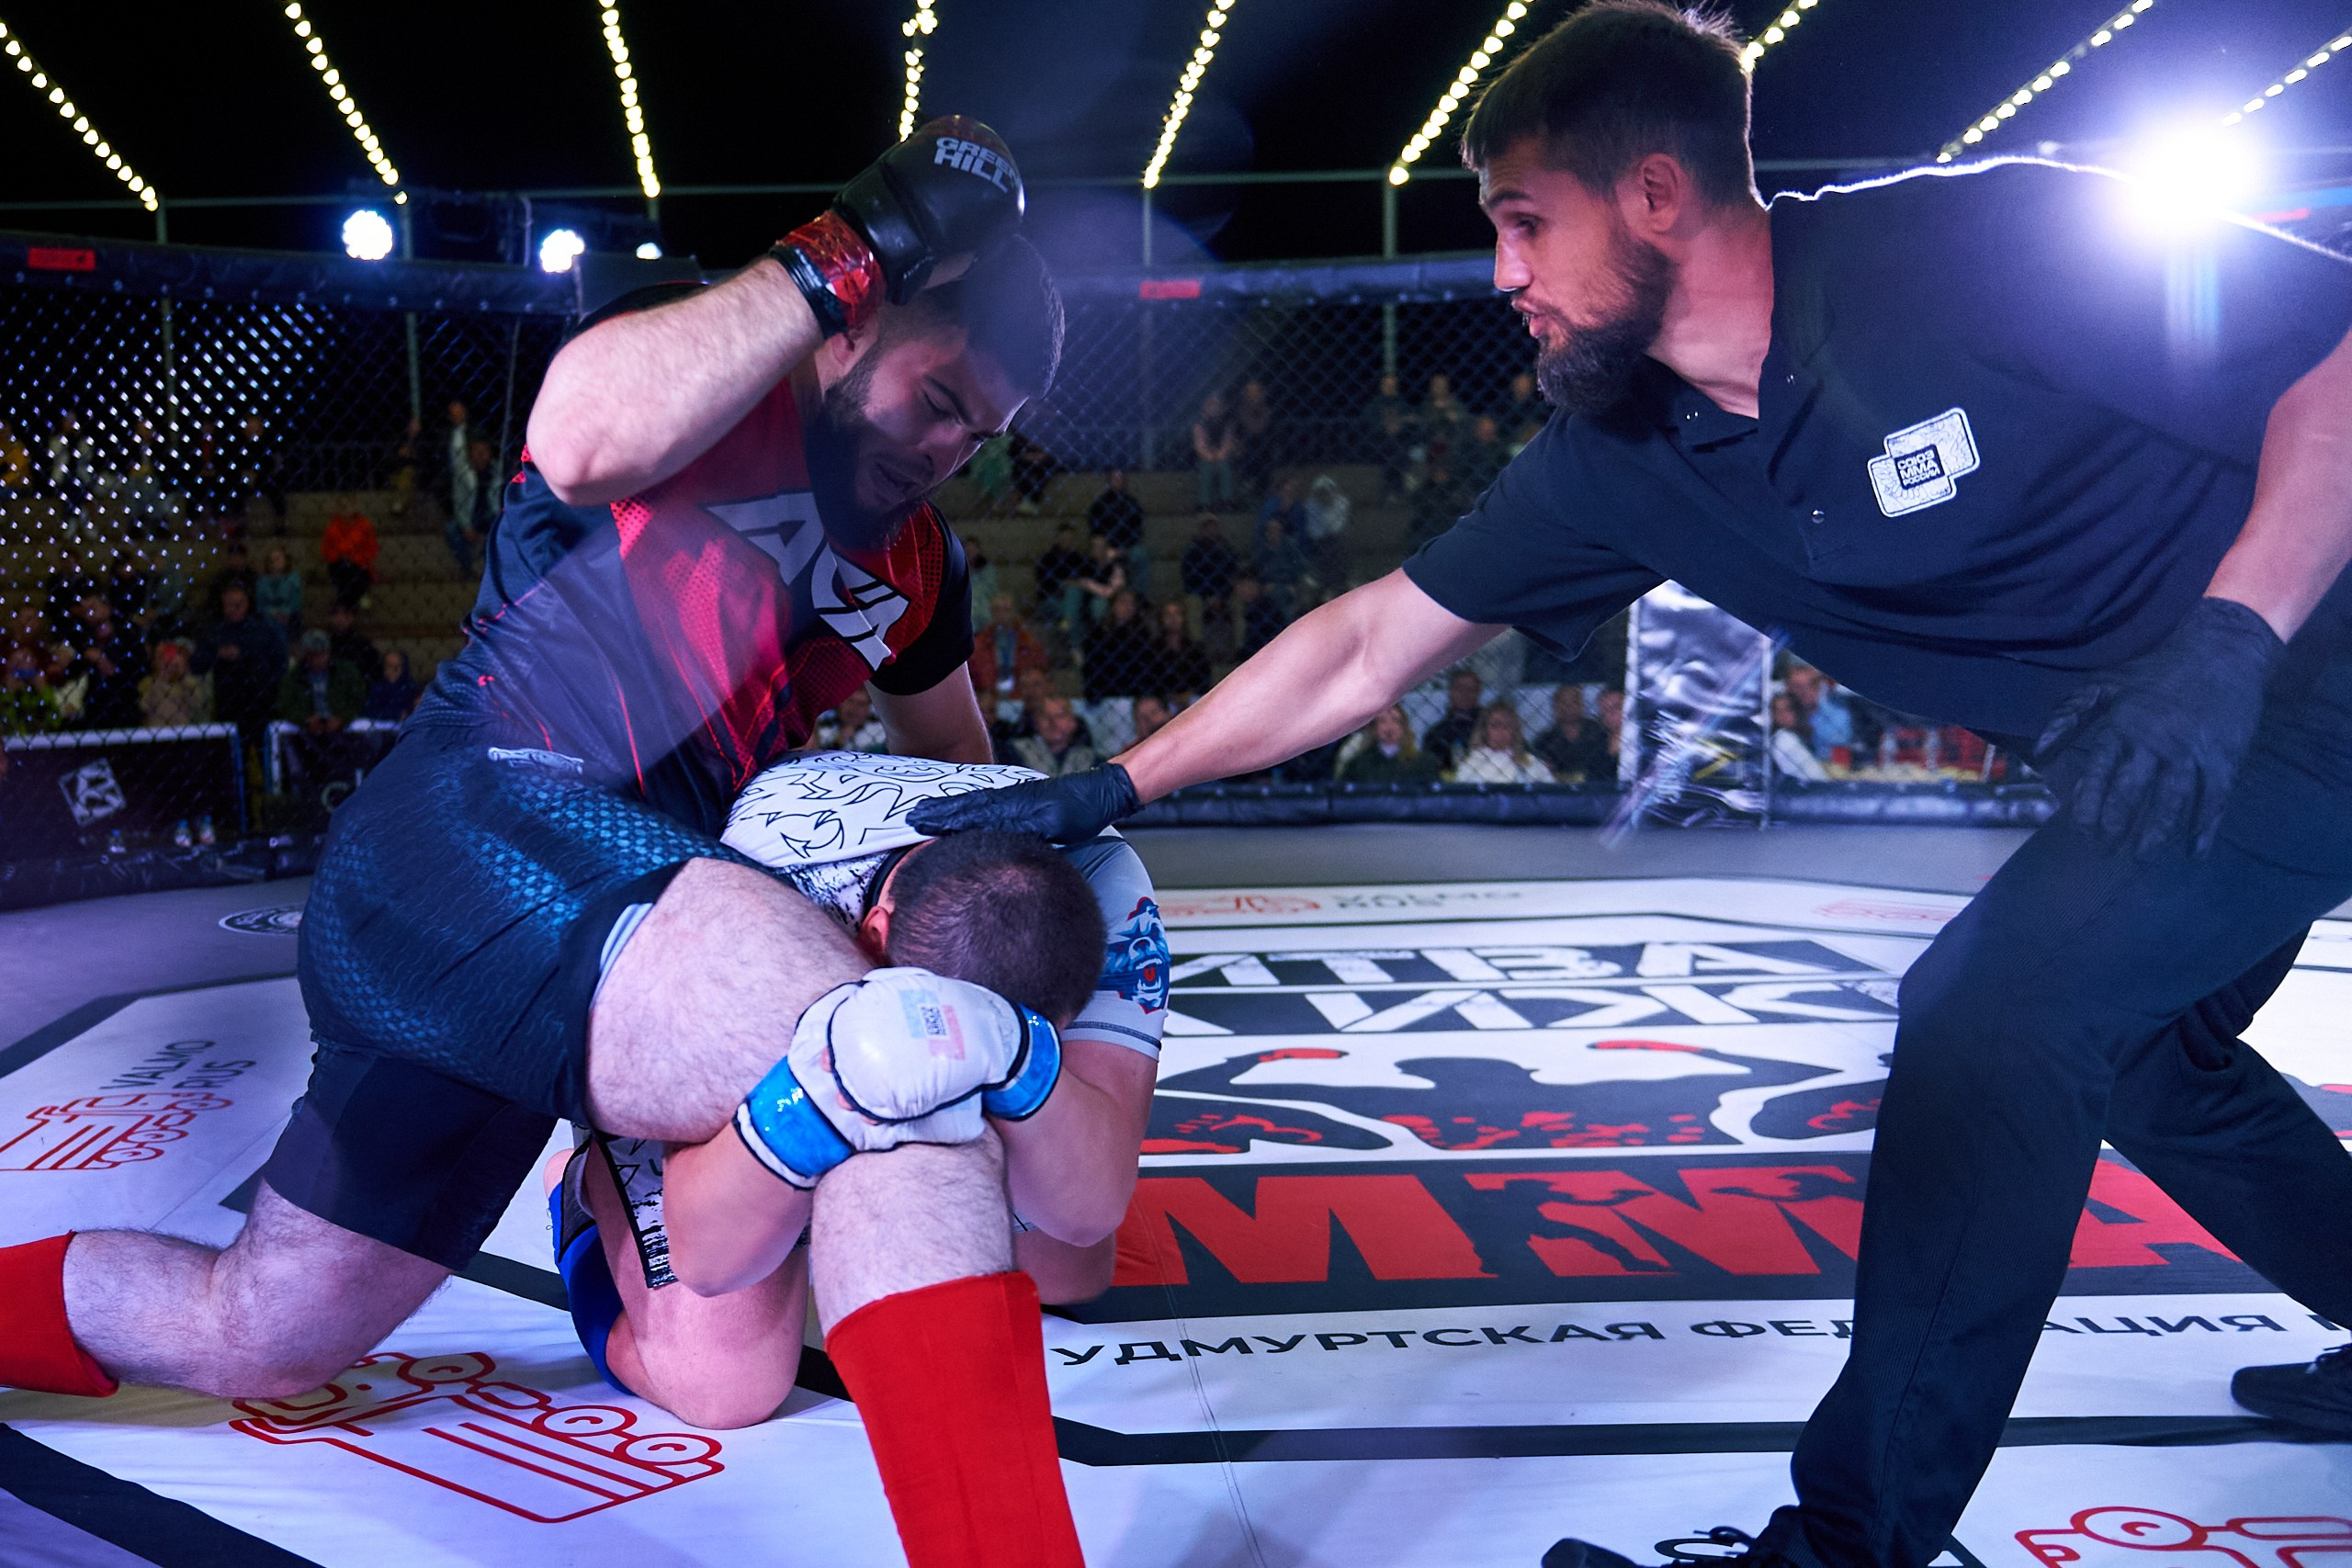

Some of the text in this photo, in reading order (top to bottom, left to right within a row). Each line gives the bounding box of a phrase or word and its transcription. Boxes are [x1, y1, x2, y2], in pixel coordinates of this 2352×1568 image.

[933, 146, 1009, 193] HILL
[935, 136, 1022, 186] GREEN
[1896, 449, 1936, 469] СОЮЗ
[1902, 468, 1941, 487] РОССИИ
[1048, 1321, 1667, 1366] УДМУРТСКАЯ
